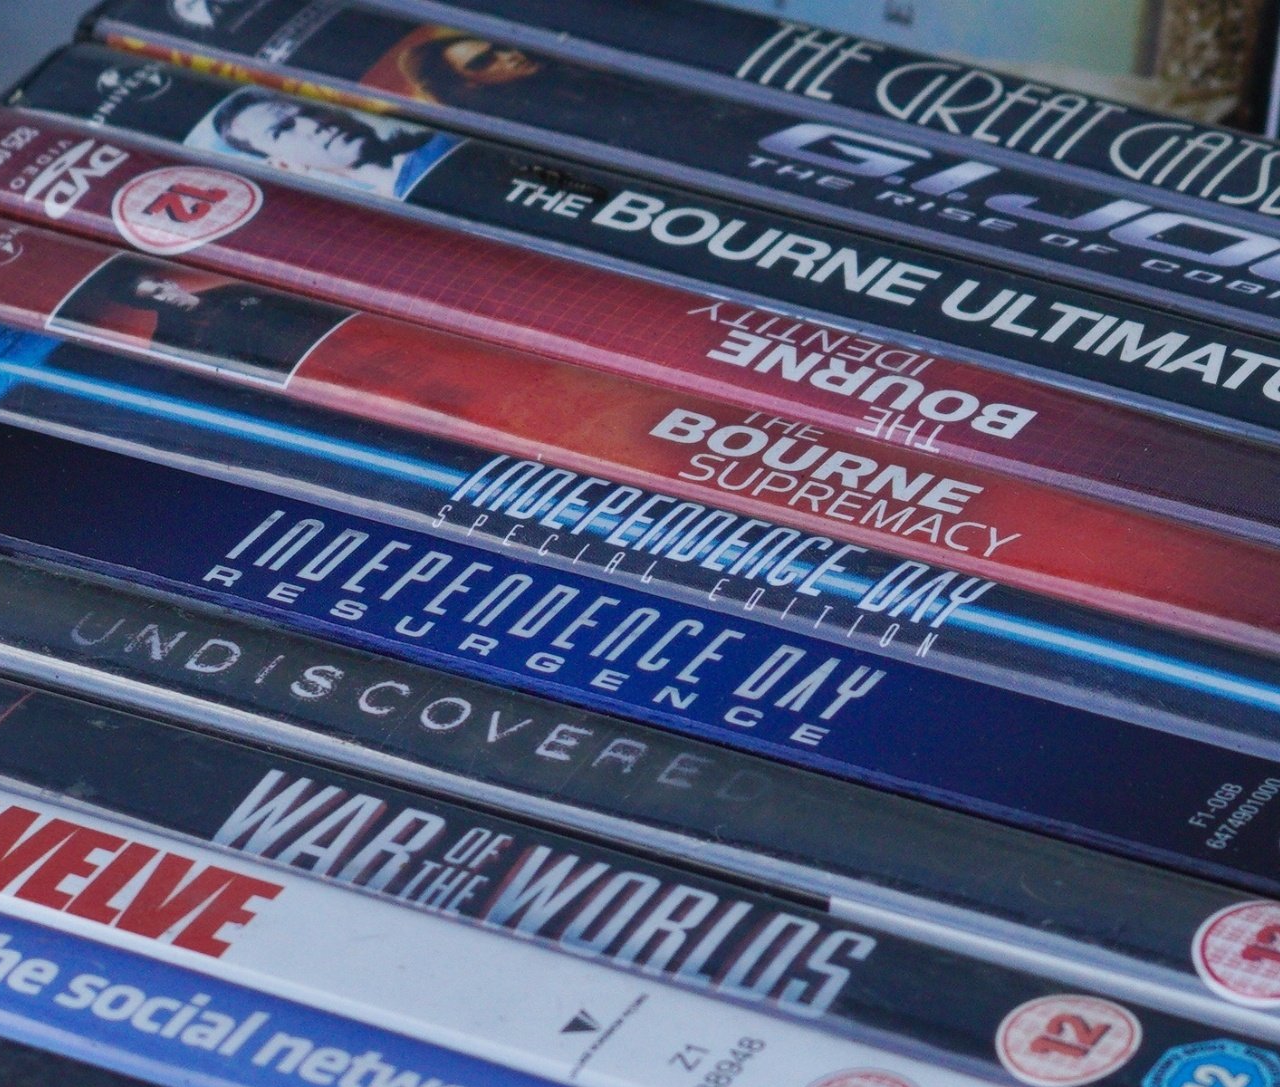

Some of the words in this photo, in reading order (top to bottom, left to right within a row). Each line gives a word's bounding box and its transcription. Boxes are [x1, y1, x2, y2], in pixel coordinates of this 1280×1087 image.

[735, 19, 874, 103] THE
[876, 62, 1127, 158] GREAT
[9, 138, 73, 192] VIDEO
[43, 144, 130, 219] DVD
[141, 181, 230, 224] 12
[747, 154, 855, 192] THE
[878, 188, 1018, 230] RISE
[1041, 231, 1118, 258] OF
[502, 178, 593, 219] THE
[589, 190, 943, 306] BOURNE
[685, 298, 937, 379] IDENTITY
[706, 330, 1039, 442] BOURNE
[649, 406, 987, 517] BOURNE
[745, 408, 826, 444] THE
[854, 405, 945, 456] THE
[450, 450, 854, 601] INDEPENDENCE
[857, 552, 998, 630] DAY
[676, 452, 1024, 551] SUPREMACY
[224, 509, 726, 687] INDEPENDENCE
[732, 644, 888, 724] DAY
[433, 501, 656, 587] SPECIAL
[718, 579, 942, 661] EDITION
[200, 564, 833, 748] RESURGENCE
[212, 767, 452, 897] WAR
[444, 824, 513, 869] OF
[406, 856, 489, 915] THE
[485, 844, 878, 1018] WORLDS
[53, 952, 270, 1059] social
[1028, 1013, 1112, 1060] 12
